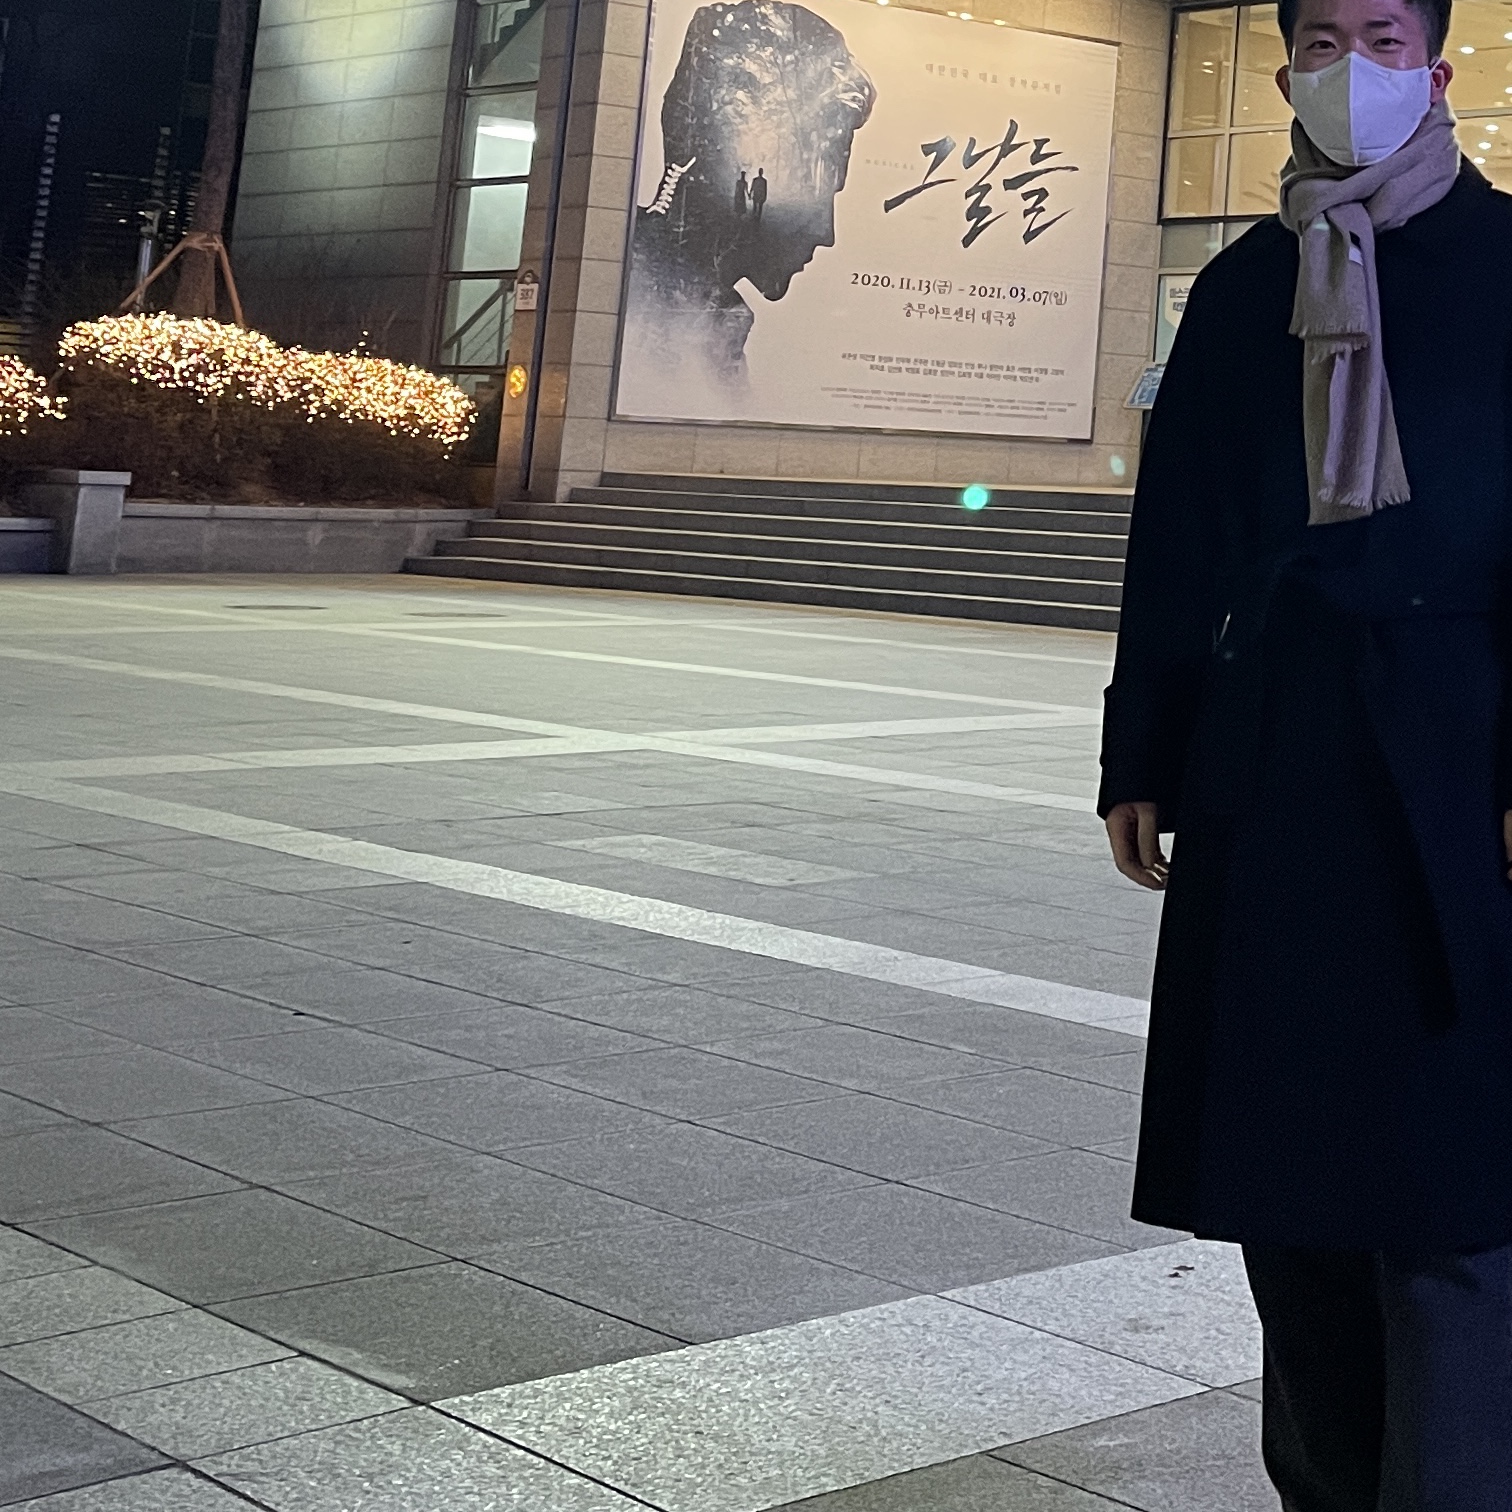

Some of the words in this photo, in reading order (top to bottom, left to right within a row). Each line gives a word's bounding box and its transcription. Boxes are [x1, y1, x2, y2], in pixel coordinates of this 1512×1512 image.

[884, 119, 1080, 249] 그날들
[902, 302, 976, 324] 충무아트센터
[982, 309, 1017, 327] 대극장
